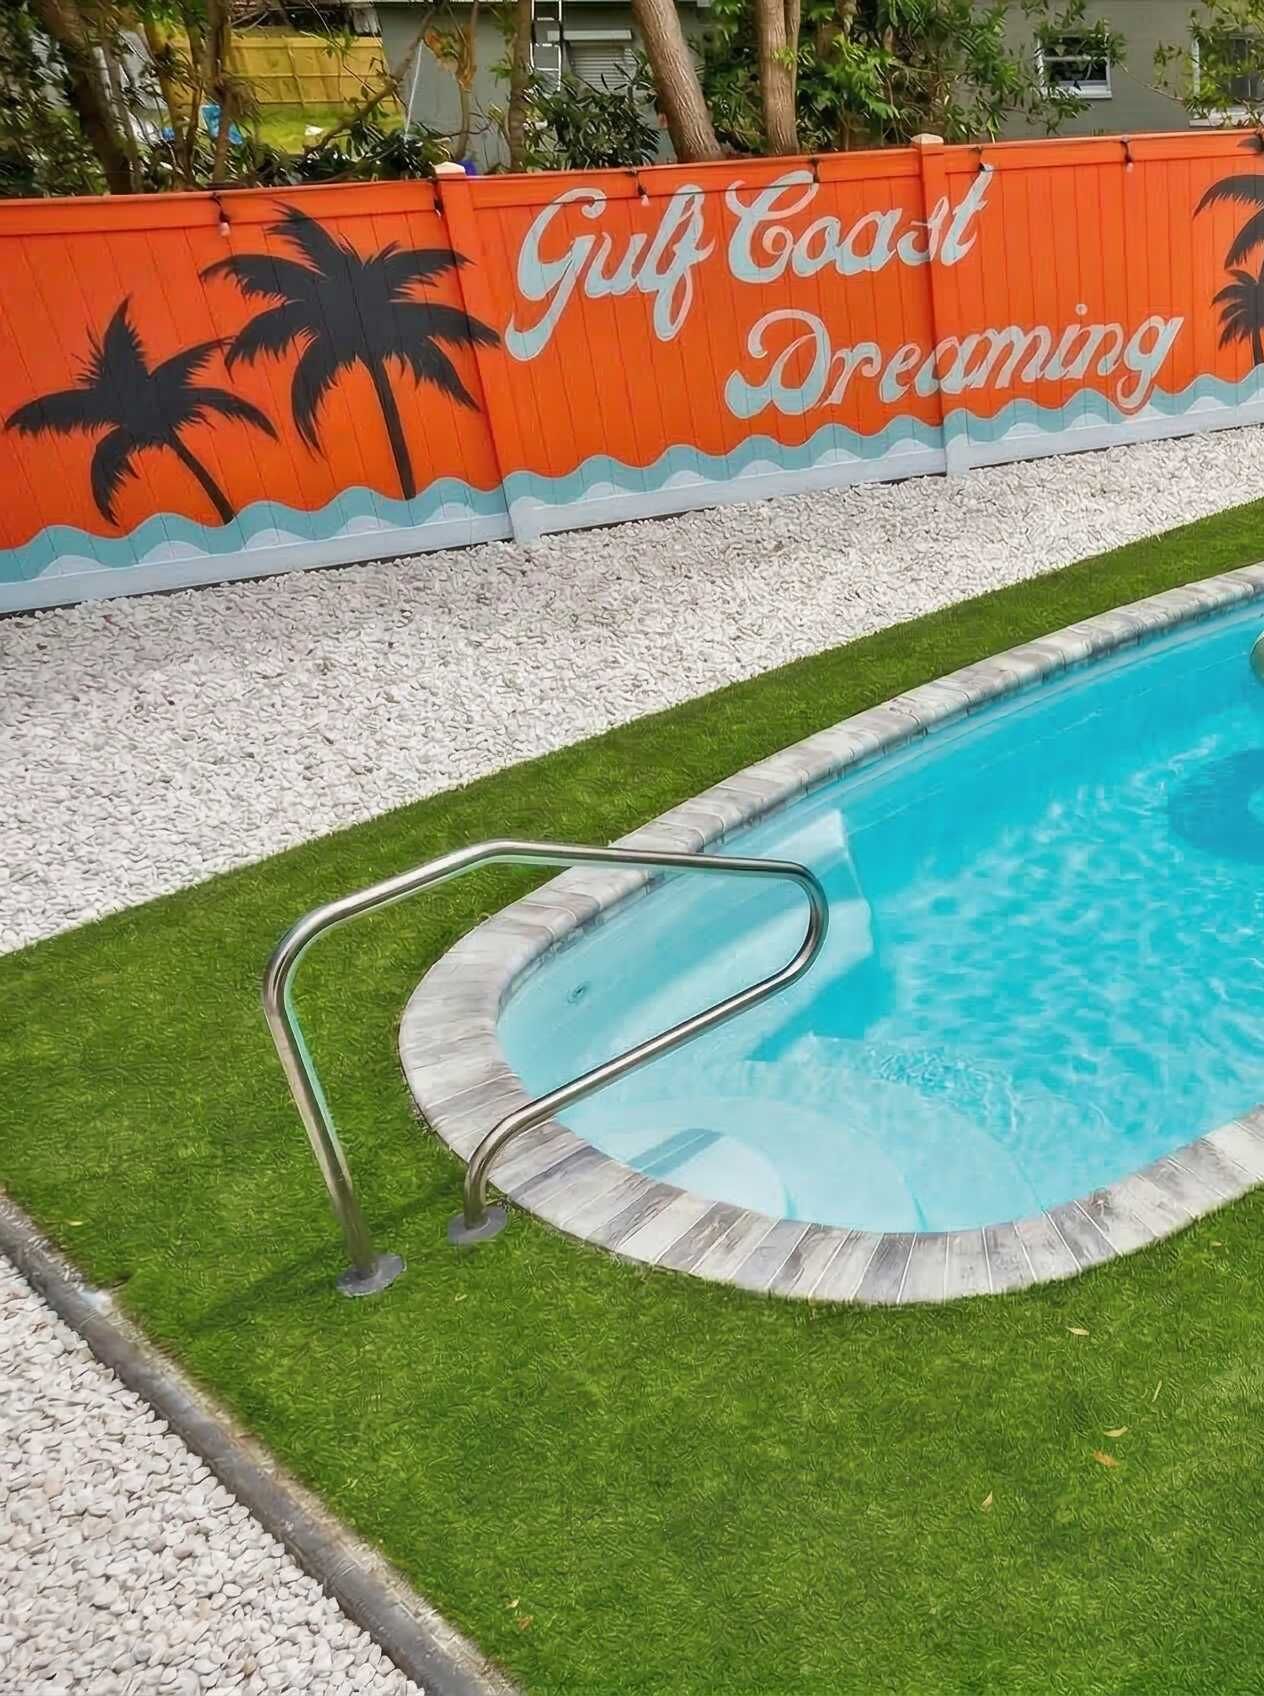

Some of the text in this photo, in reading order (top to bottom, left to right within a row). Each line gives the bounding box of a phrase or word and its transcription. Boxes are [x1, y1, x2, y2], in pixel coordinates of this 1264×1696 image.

[504, 163, 994, 362] Gulf Coast
[724, 303, 1184, 420] Dreaming
